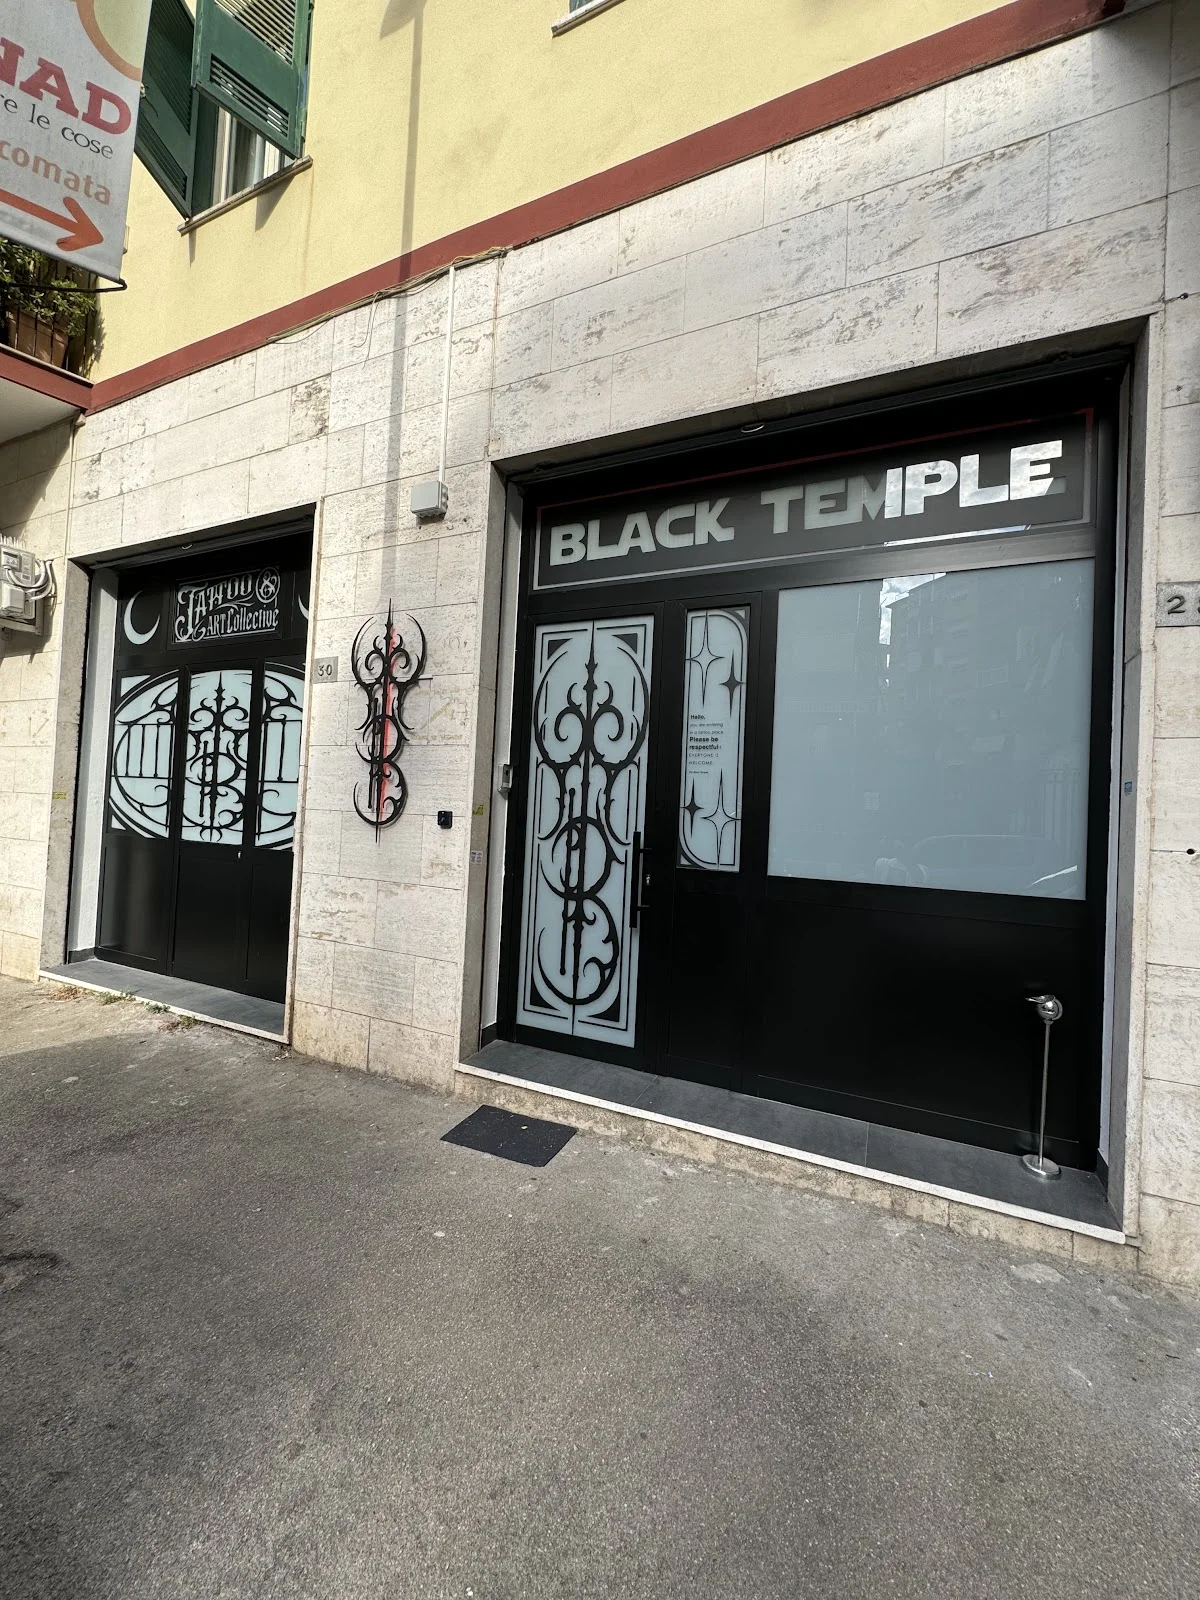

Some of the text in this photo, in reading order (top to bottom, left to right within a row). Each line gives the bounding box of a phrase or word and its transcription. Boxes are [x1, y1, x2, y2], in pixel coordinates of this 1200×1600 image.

[0, 93, 114, 159] e le cose
[550, 439, 1067, 567] BLACK TEMPLE
[1167, 594, 1200, 615] 2
[317, 664, 333, 677] 30
